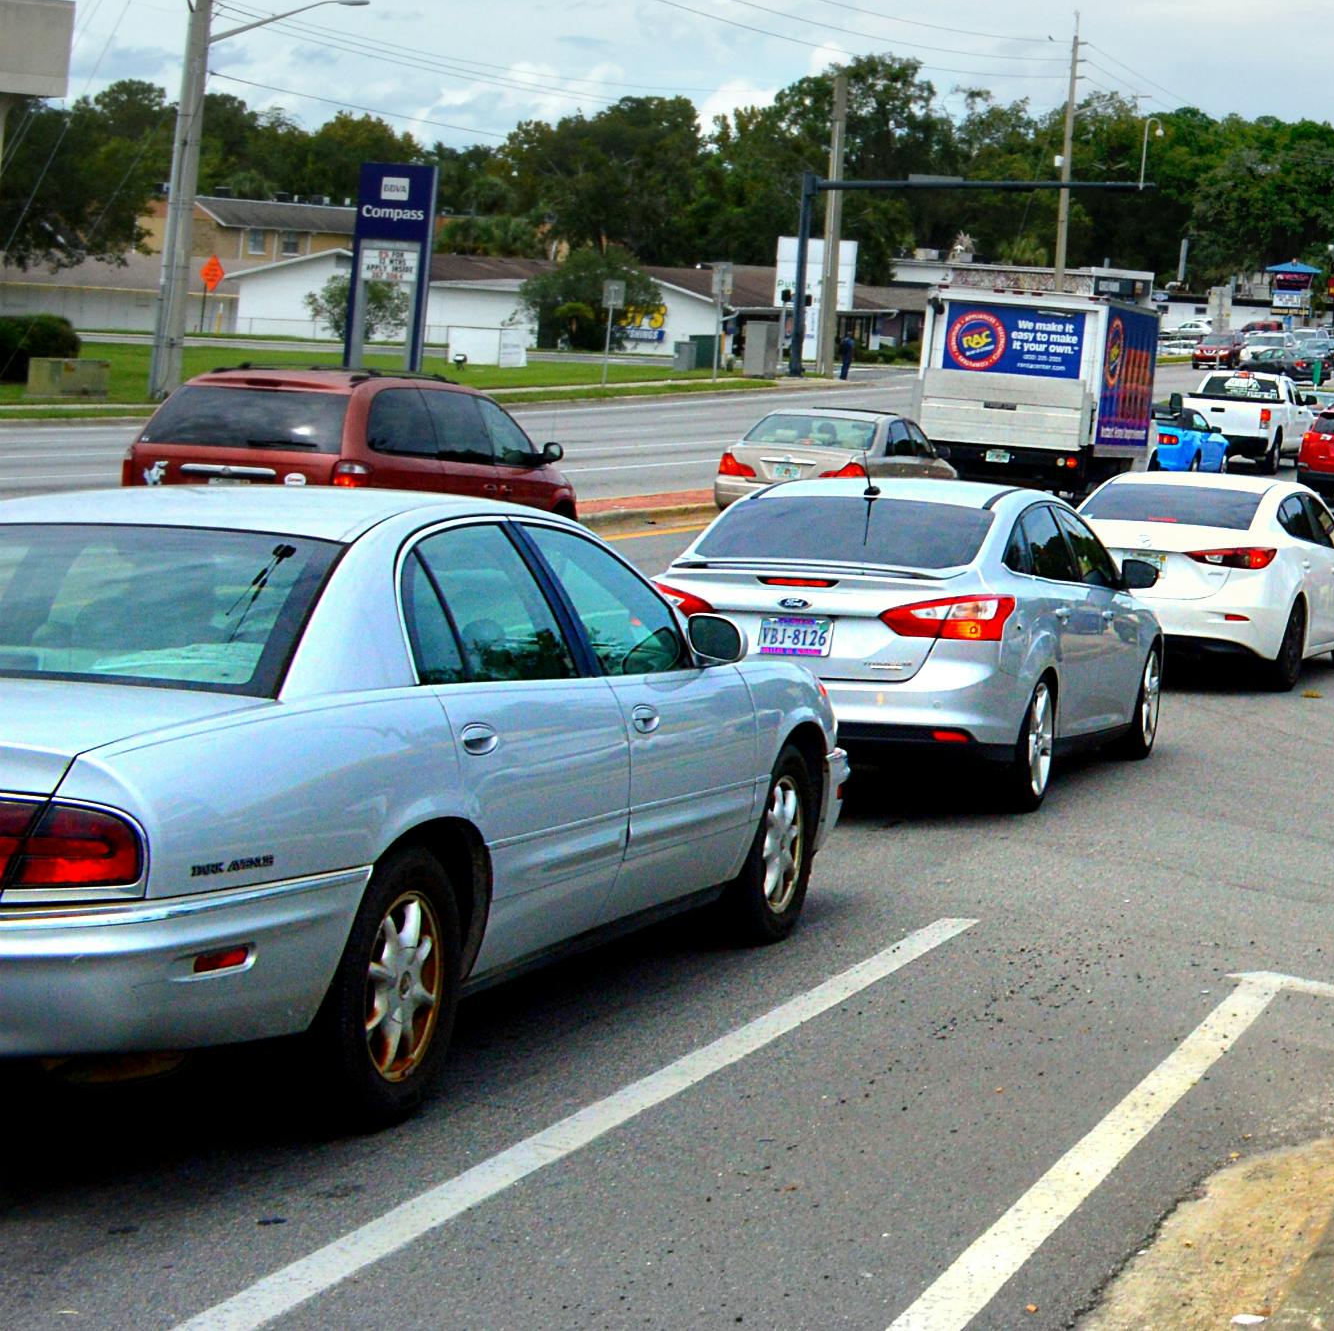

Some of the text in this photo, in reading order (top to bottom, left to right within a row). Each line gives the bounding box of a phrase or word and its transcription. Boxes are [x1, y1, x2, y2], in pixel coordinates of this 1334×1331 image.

[384, 184, 407, 194] BBVA
[362, 205, 424, 221] Compass
[1018, 320, 1075, 333] We make it
[962, 330, 992, 349] RAC
[1011, 331, 1079, 344] easy to make
[1012, 340, 1022, 350] it
[1023, 342, 1048, 352] your
[763, 627, 828, 646] VBJ-8126
